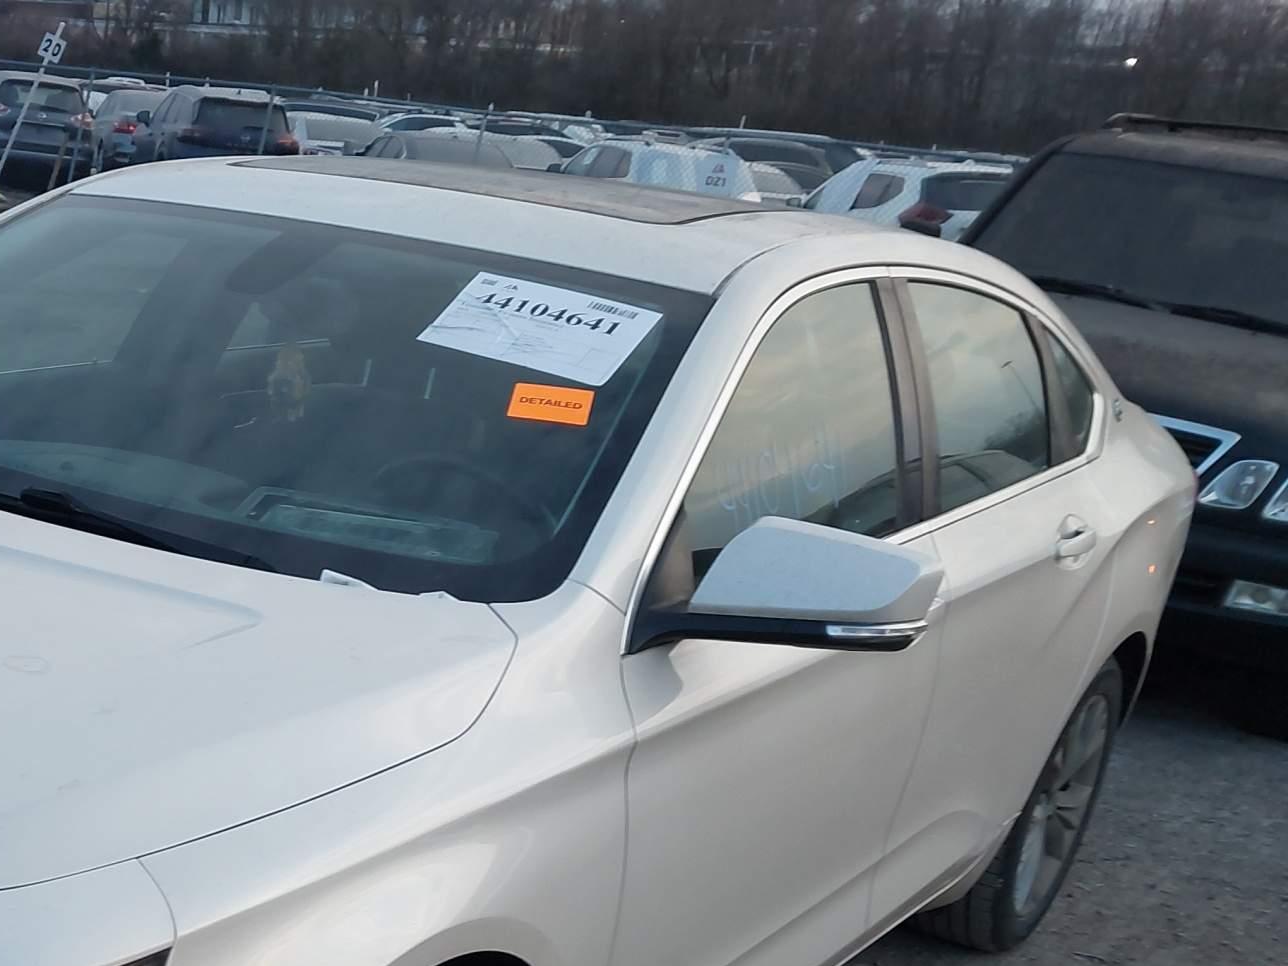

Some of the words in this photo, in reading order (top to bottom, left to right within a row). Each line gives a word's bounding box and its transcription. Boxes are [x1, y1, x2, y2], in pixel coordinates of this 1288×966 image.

[42, 38, 62, 57] 20
[476, 292, 621, 336] 44104641
[519, 396, 583, 410] DETAILED
